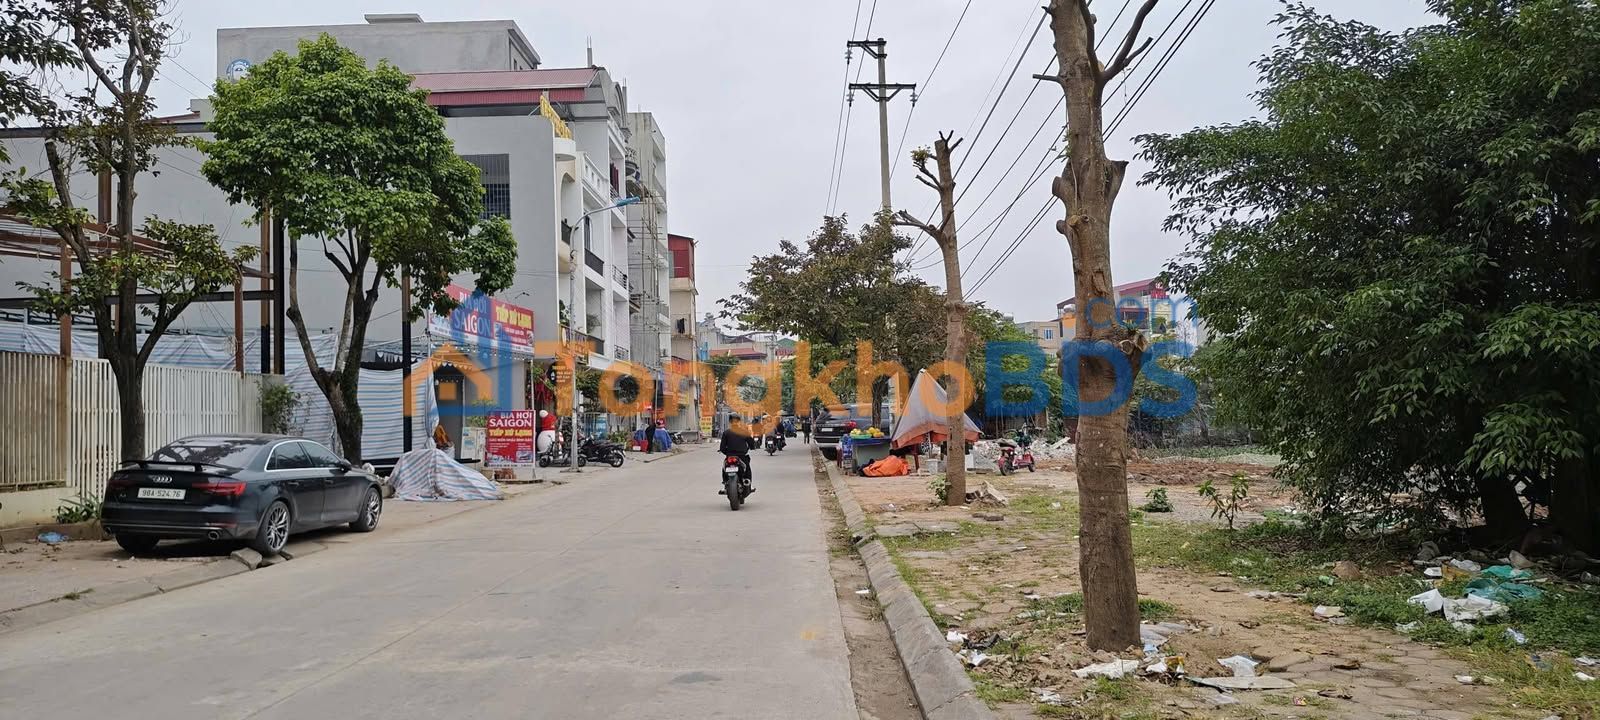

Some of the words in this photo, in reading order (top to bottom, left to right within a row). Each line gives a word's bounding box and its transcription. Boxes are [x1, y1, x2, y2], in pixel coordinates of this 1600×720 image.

[453, 308, 491, 337] SAIGON
[501, 411, 515, 419] BIA
[516, 410, 532, 419] HƠI
[489, 418, 532, 427] SAIGON
